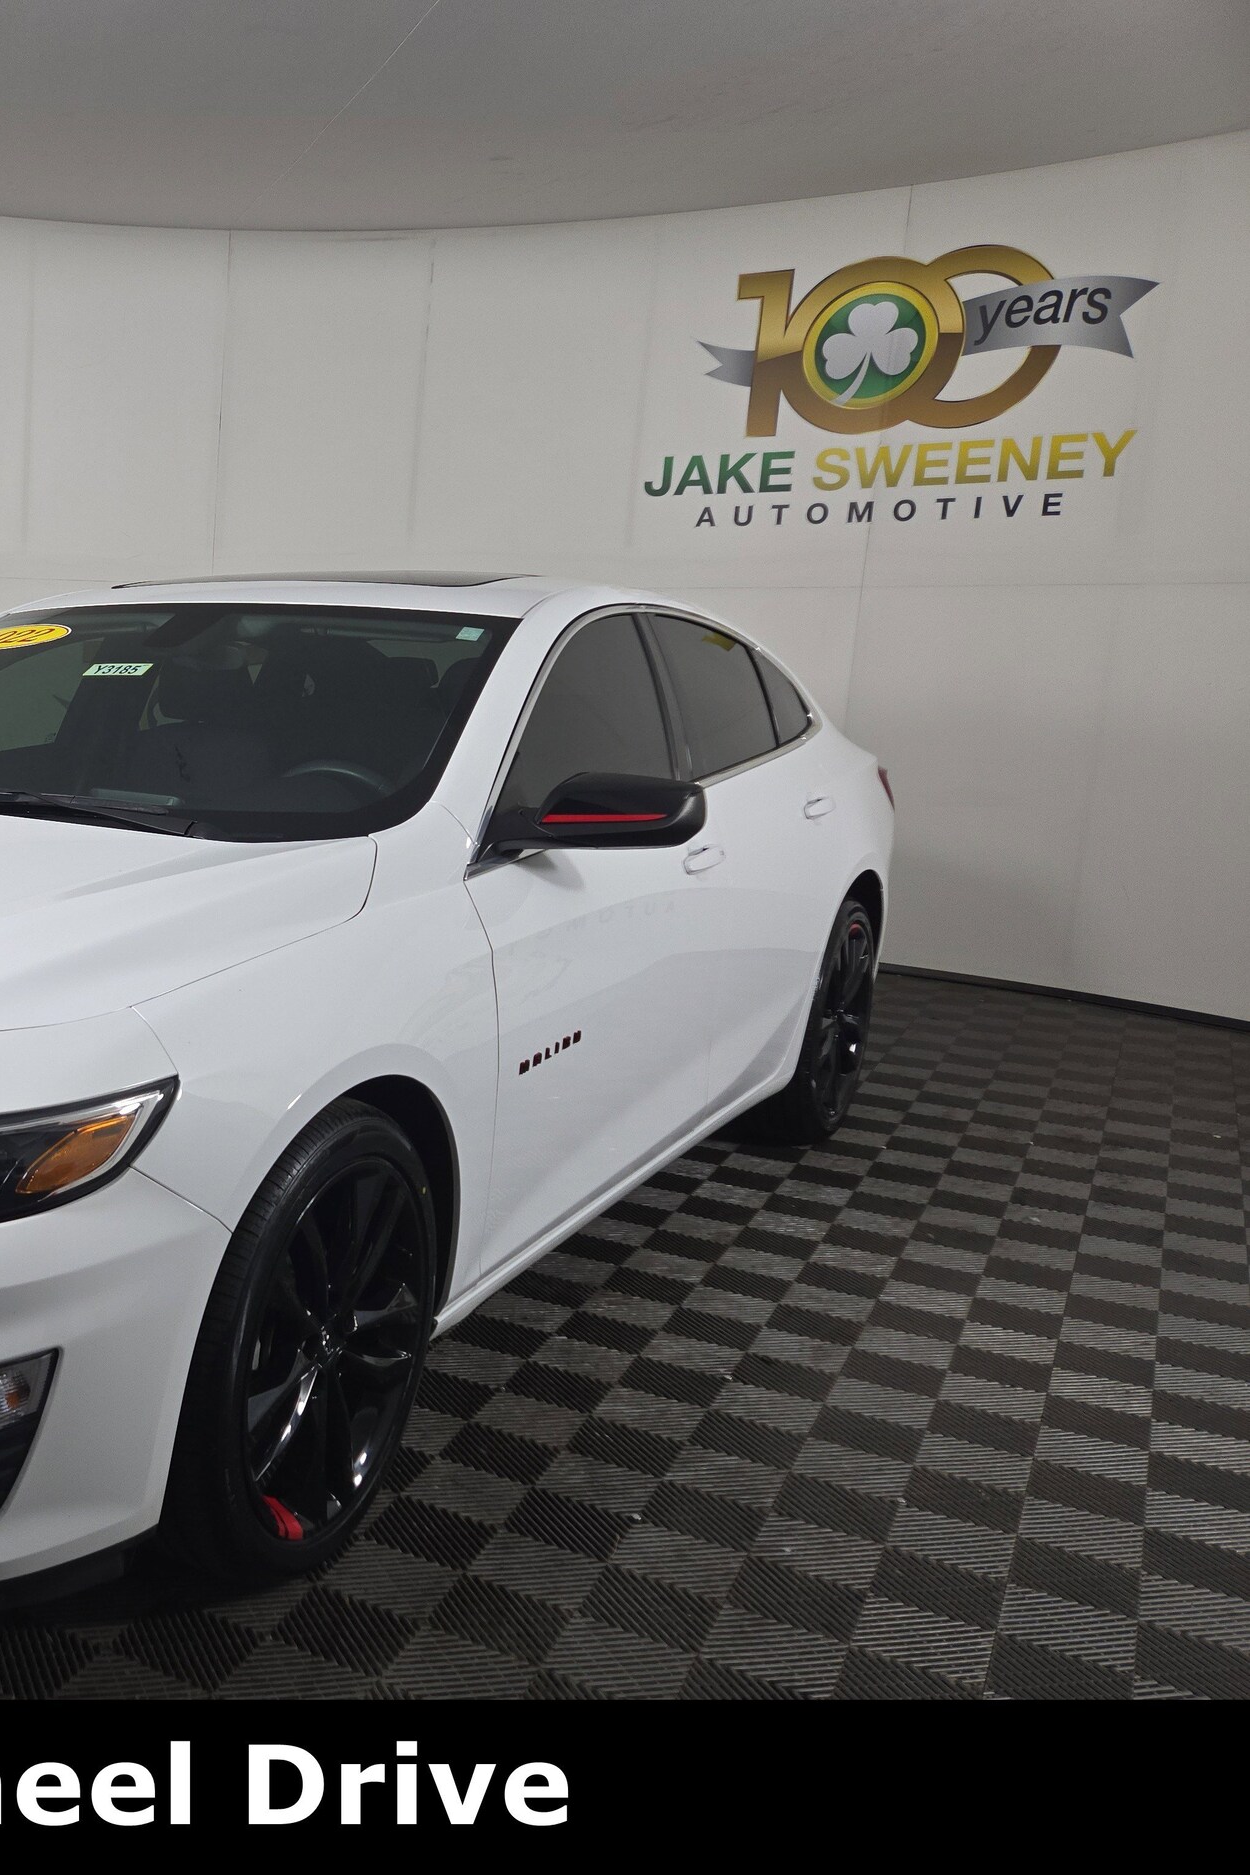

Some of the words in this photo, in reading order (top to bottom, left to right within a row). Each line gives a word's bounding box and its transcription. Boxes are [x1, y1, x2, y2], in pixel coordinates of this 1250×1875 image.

[974, 285, 1112, 346] years
[644, 451, 796, 496] JAKE
[812, 429, 1138, 491] SWEENEY
[696, 493, 1063, 527] AUTOMOTIVE
[94, 664, 142, 675] Y3185
[519, 1030, 581, 1075] MALIBU
